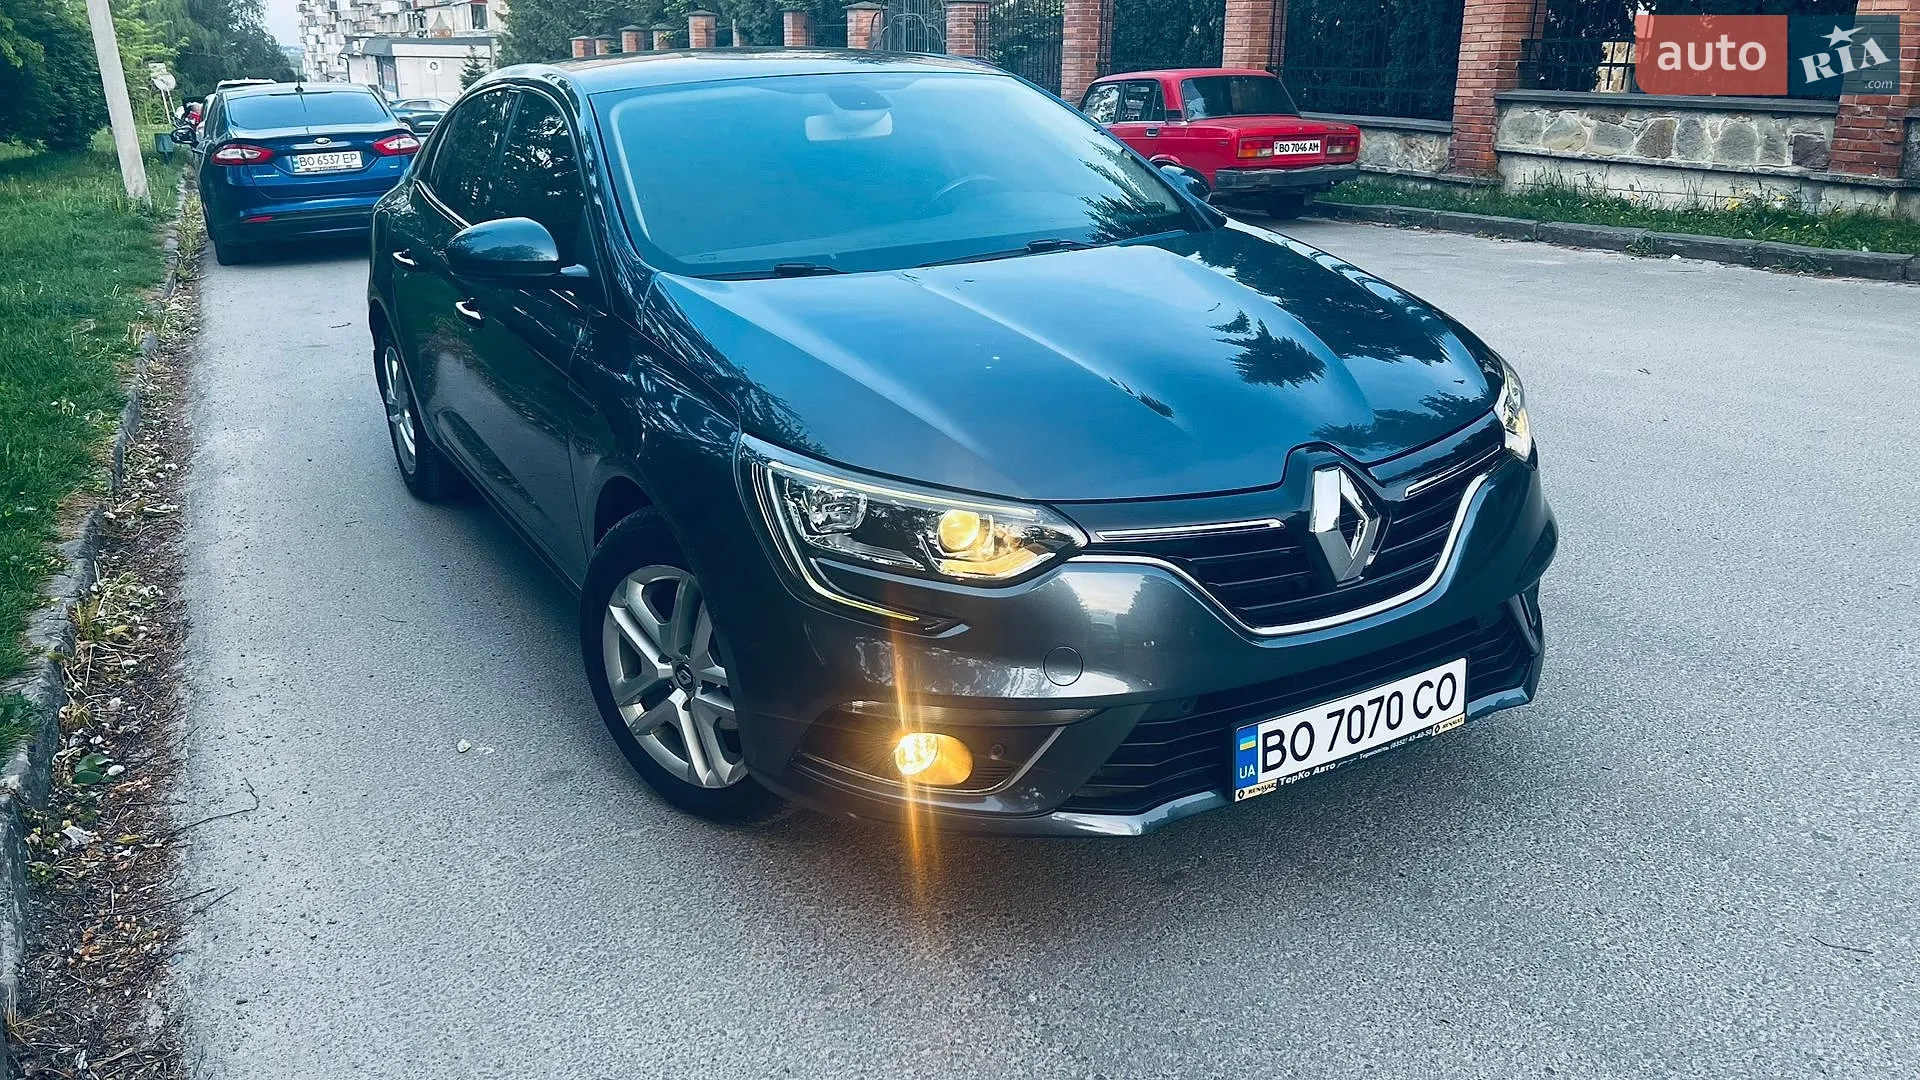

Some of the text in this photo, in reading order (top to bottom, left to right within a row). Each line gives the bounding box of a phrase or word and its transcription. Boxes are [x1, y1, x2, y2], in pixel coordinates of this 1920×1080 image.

[1279, 143, 1290, 153] BO
[299, 153, 357, 167] BO 6537 EP
[1239, 672, 1457, 779] UA BO 7070 CO
